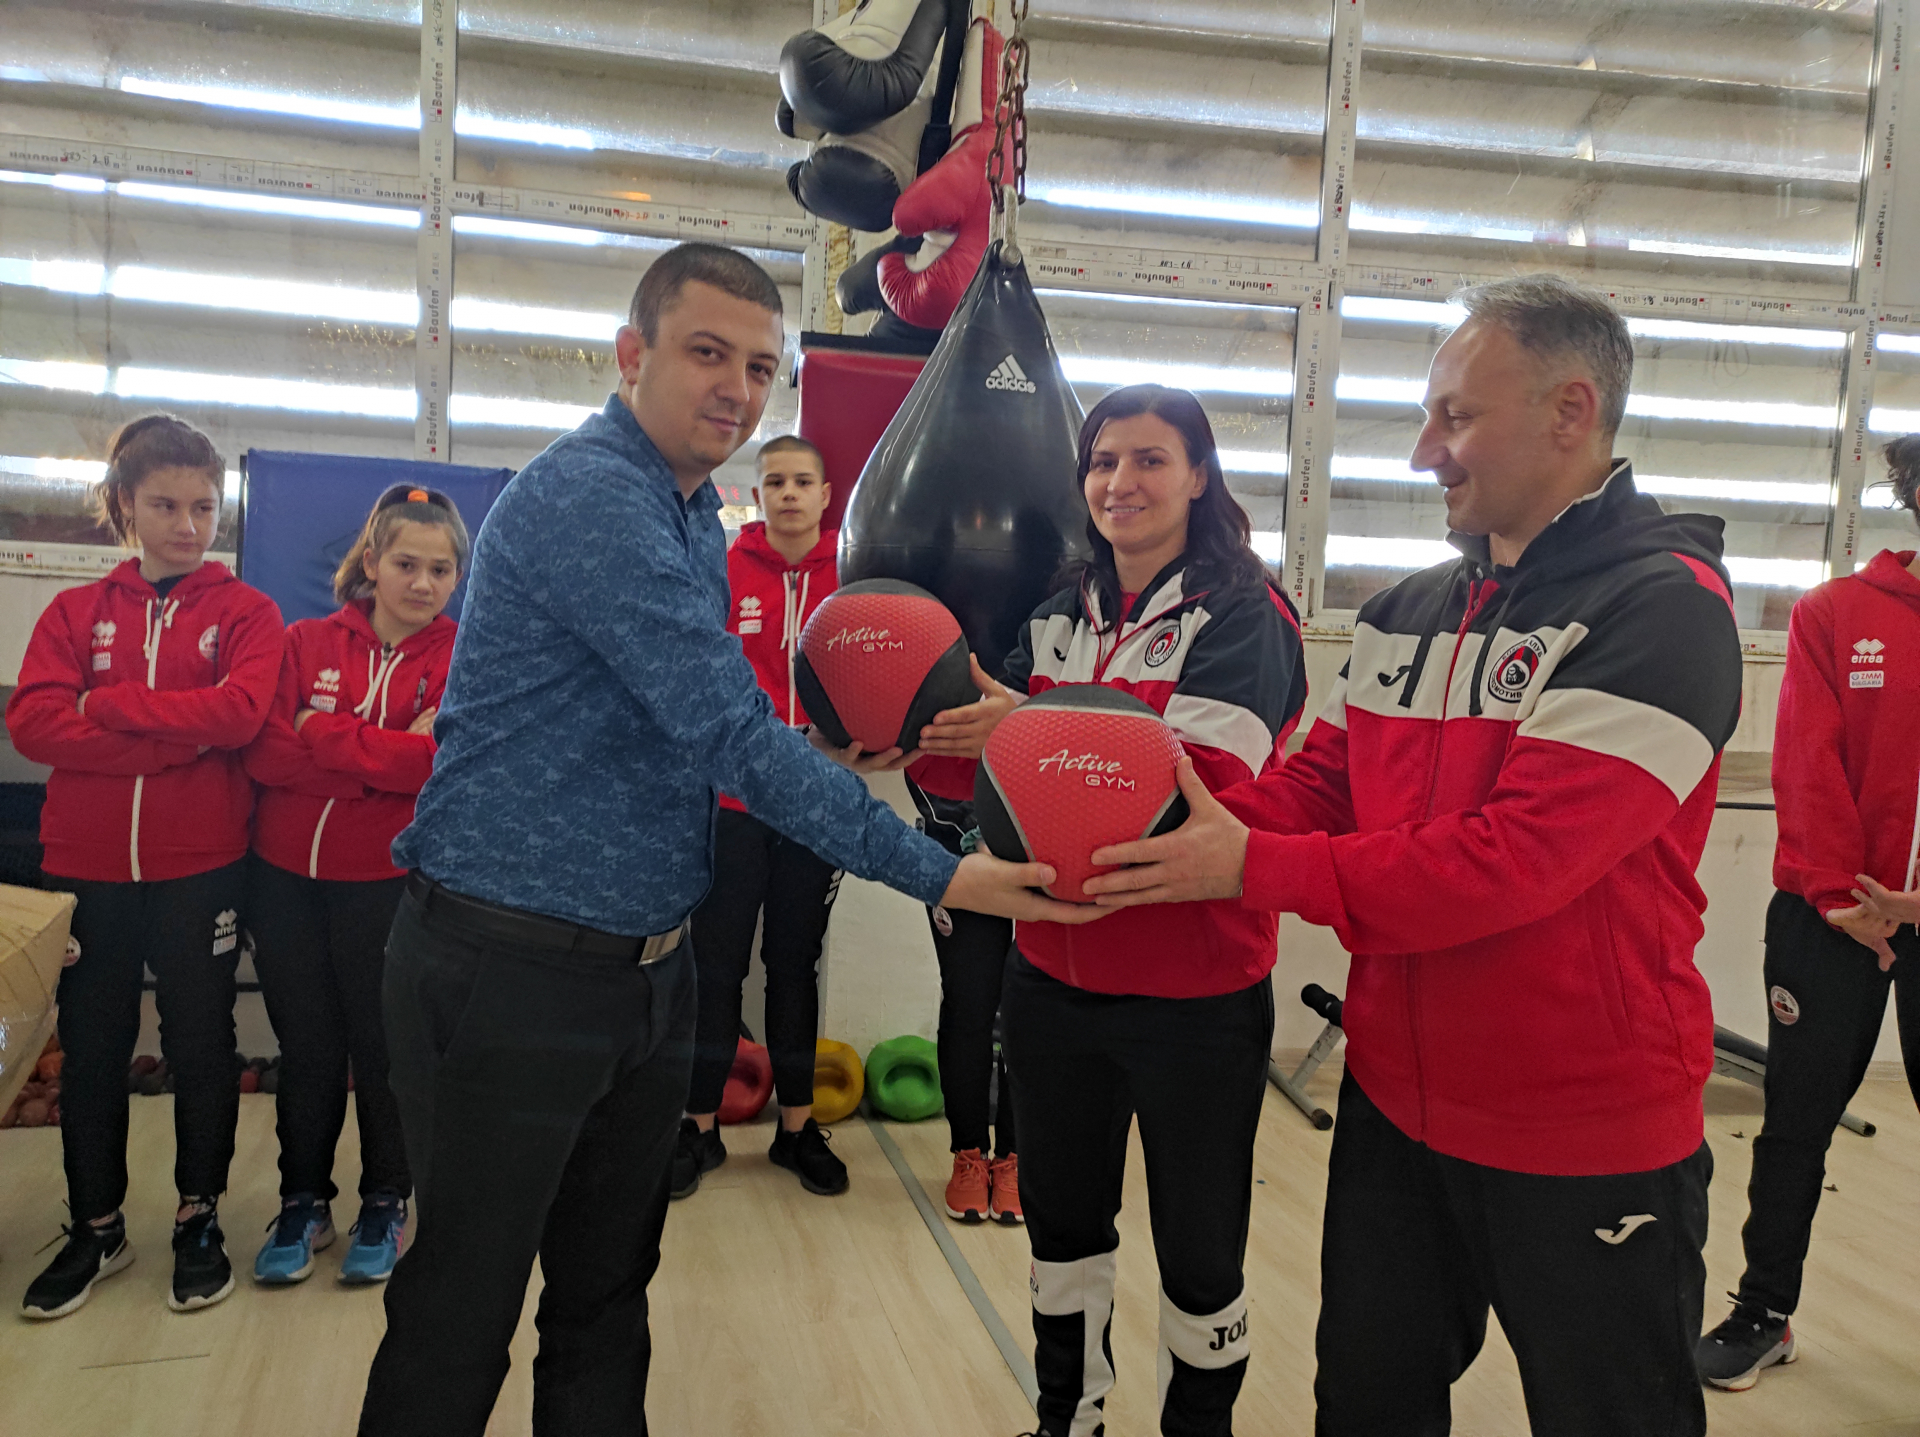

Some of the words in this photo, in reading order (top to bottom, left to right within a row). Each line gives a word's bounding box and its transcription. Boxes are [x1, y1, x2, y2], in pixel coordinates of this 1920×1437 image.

[432, 62, 443, 107] Baufen
[430, 178, 441, 221] Baufen
[569, 203, 612, 217] Baufen
[678, 215, 720, 228] Baufen
[1039, 264, 1077, 277] Baufen
[1135, 272, 1171, 284] Baufen
[1229, 279, 1266, 292] Baufen
[428, 290, 439, 334] Baufen
[1663, 296, 1698, 306] Baufen
[1751, 301, 1785, 312] Baufen
[1864, 320, 1875, 358] Baufen
[985, 376, 1036, 394] adidas
[1306, 362, 1317, 400] Baufen
[426, 402, 437, 445] Baufen
[1854, 417, 1865, 454] Baufen
[1300, 458, 1311, 496] Baufen
[1845, 512, 1856, 549] Baufen
[1294, 554, 1305, 590] Baufen
[826, 626, 891, 652] Active
[862, 640, 904, 652] GYM
[1860, 672, 1882, 680] ZMM
[1038, 748, 1123, 777] Active
[1085, 773, 1135, 791] GYM
